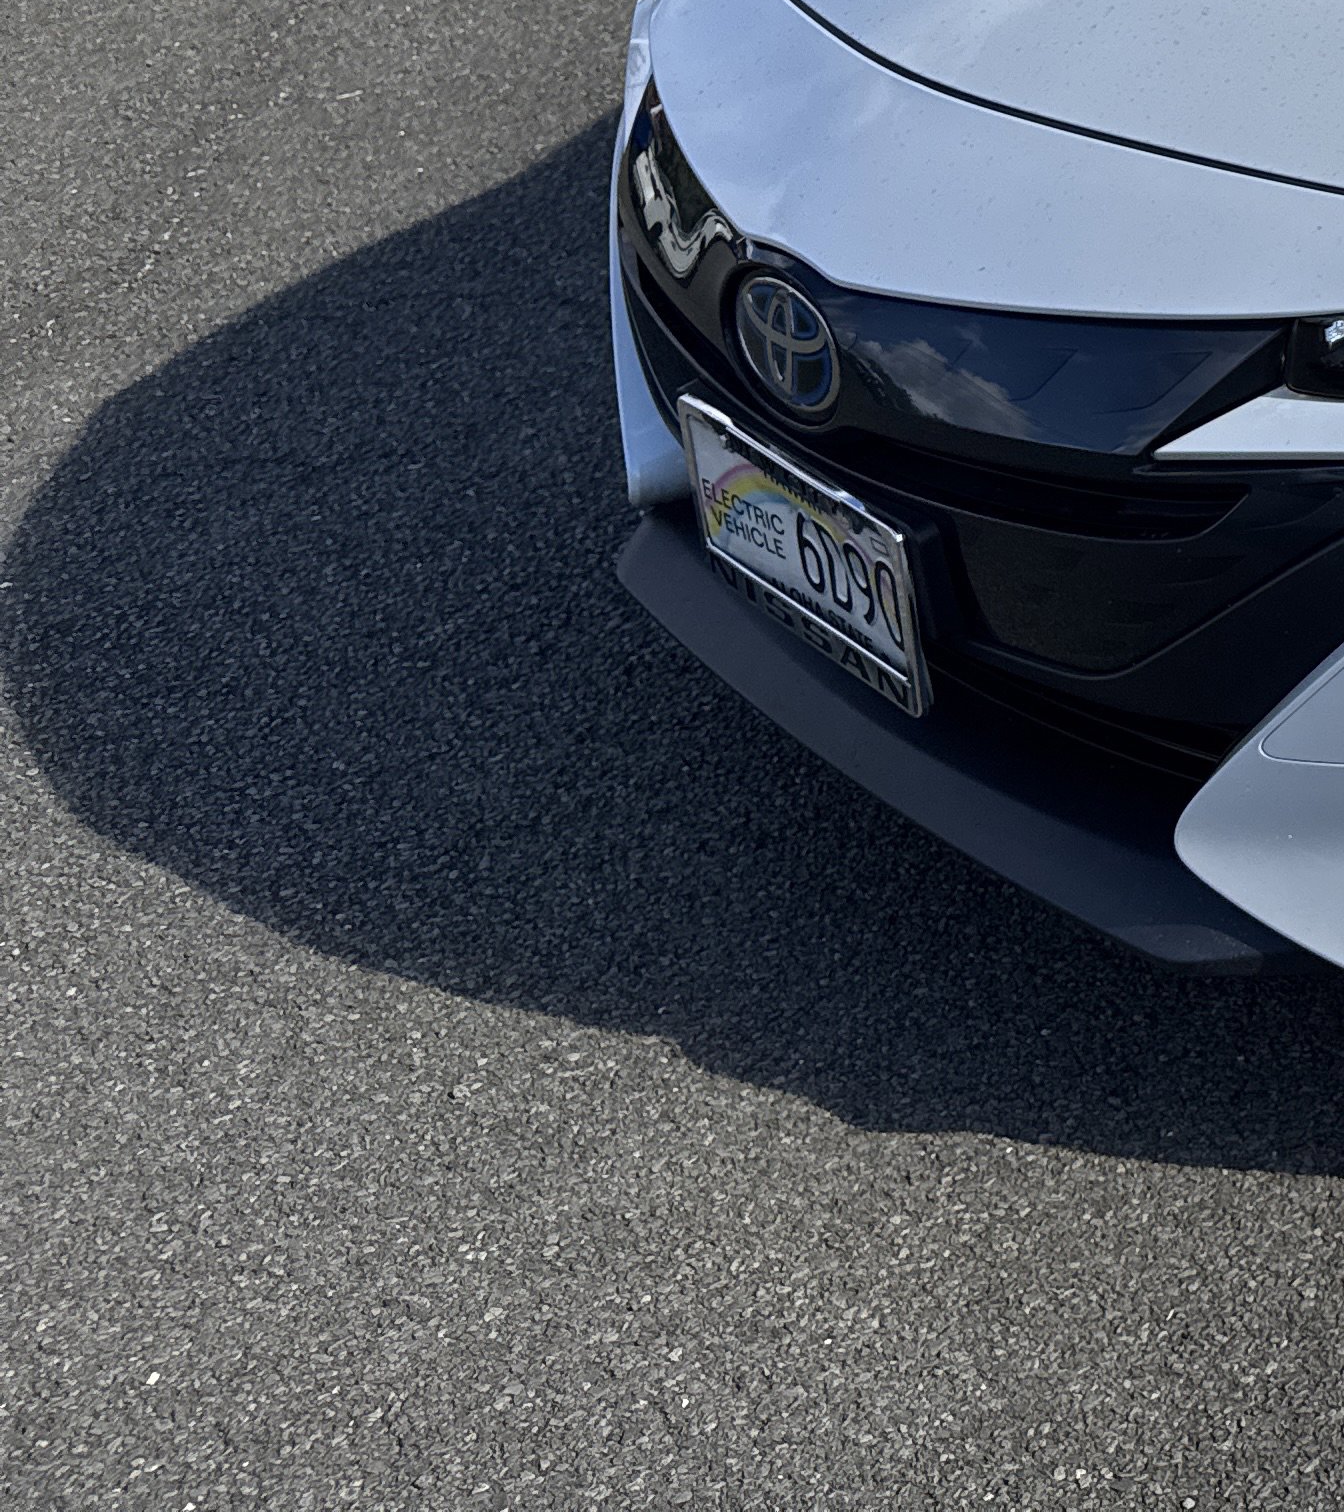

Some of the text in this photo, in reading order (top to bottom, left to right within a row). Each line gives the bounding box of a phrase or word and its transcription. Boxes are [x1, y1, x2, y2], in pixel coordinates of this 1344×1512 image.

[702, 478, 785, 536] ELECTRIC
[711, 505, 787, 560] VEHICLE
[709, 552, 909, 709] NISSAN
